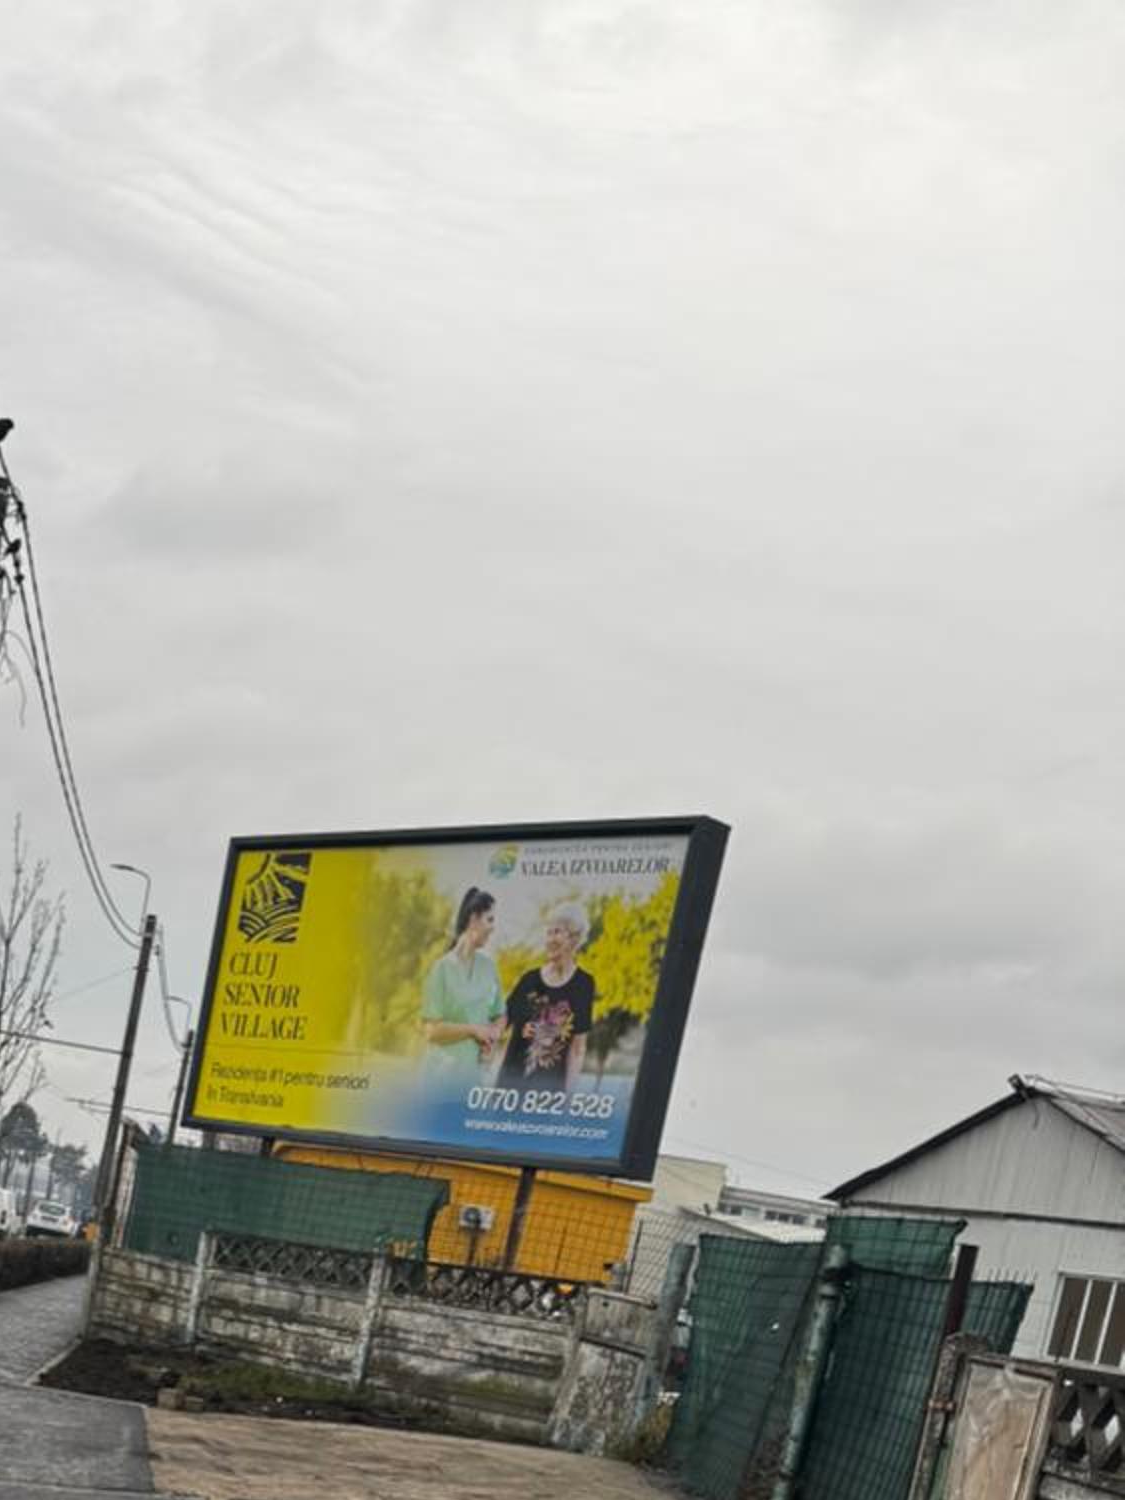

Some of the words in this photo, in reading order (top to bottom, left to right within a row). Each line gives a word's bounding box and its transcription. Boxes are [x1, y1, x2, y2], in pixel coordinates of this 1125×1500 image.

[521, 858, 567, 877] VALEA
[228, 952, 278, 980] CLUJ
[223, 983, 300, 1009] SENIOR
[221, 1011, 308, 1040] VILLAGE
[467, 1086, 519, 1112] 0770
[522, 1090, 566, 1116] 822
[569, 1093, 615, 1119] 528
